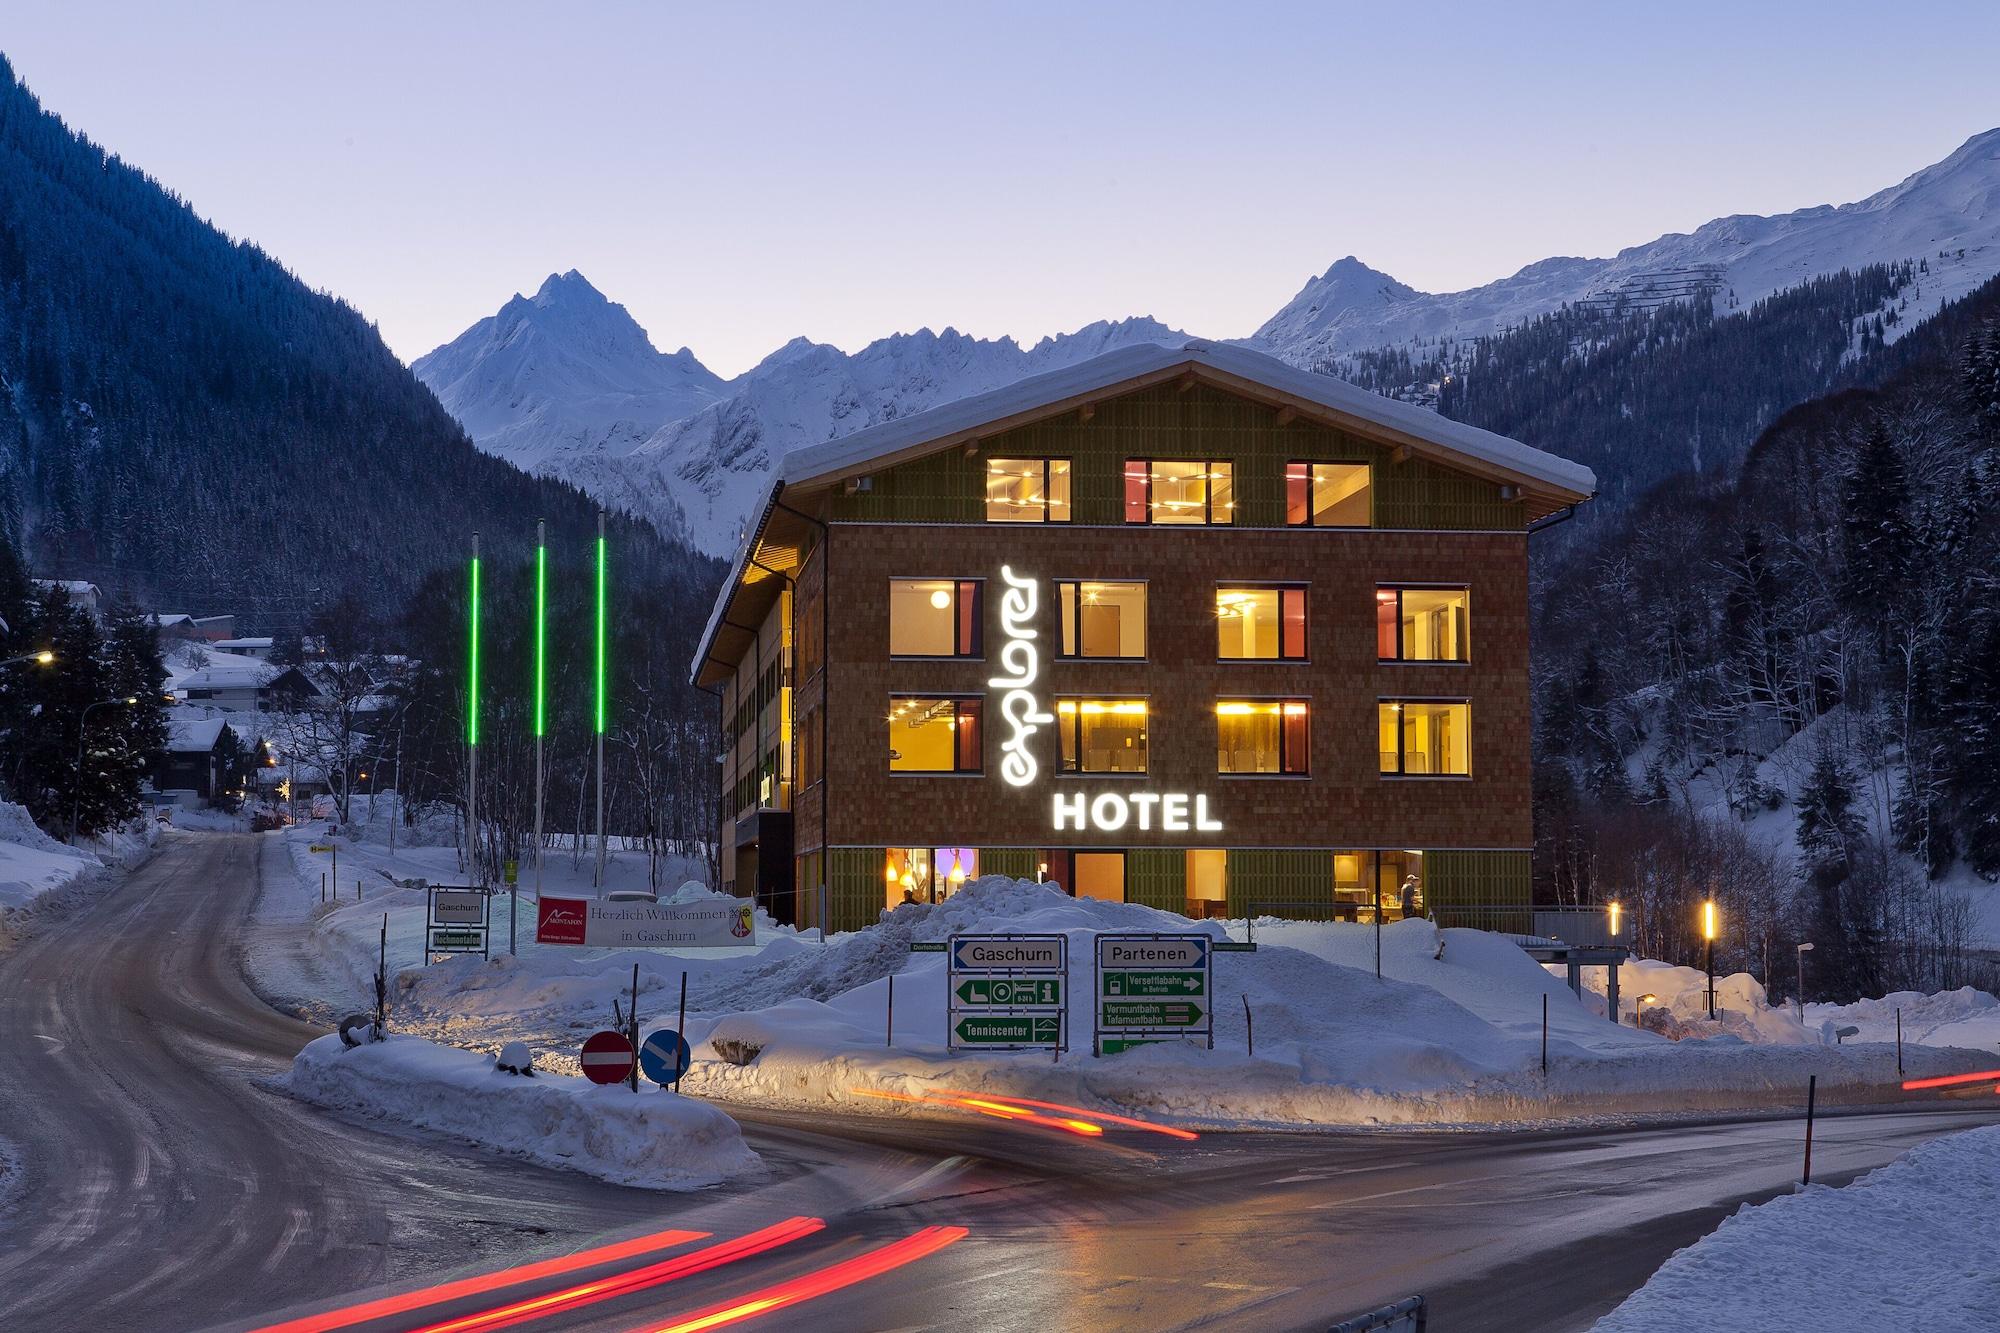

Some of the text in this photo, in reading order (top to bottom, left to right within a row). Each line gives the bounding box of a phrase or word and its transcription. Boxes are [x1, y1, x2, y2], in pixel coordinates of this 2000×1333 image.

[987, 564, 1054, 788] explorer
[1052, 793, 1223, 831] HOTEL
[438, 903, 480, 911] Gaschurn
[591, 907, 727, 920] Herzlich Willkommen
[621, 929, 696, 941] in Gaschurn
[972, 946, 1053, 961] Gaschurn
[1112, 946, 1187, 960] Partenen
[1106, 1004, 1160, 1014] Vermuntbahn
[1106, 1014, 1163, 1024] Tafamuntbahn
[966, 1024, 1027, 1037] Tenniscenter
